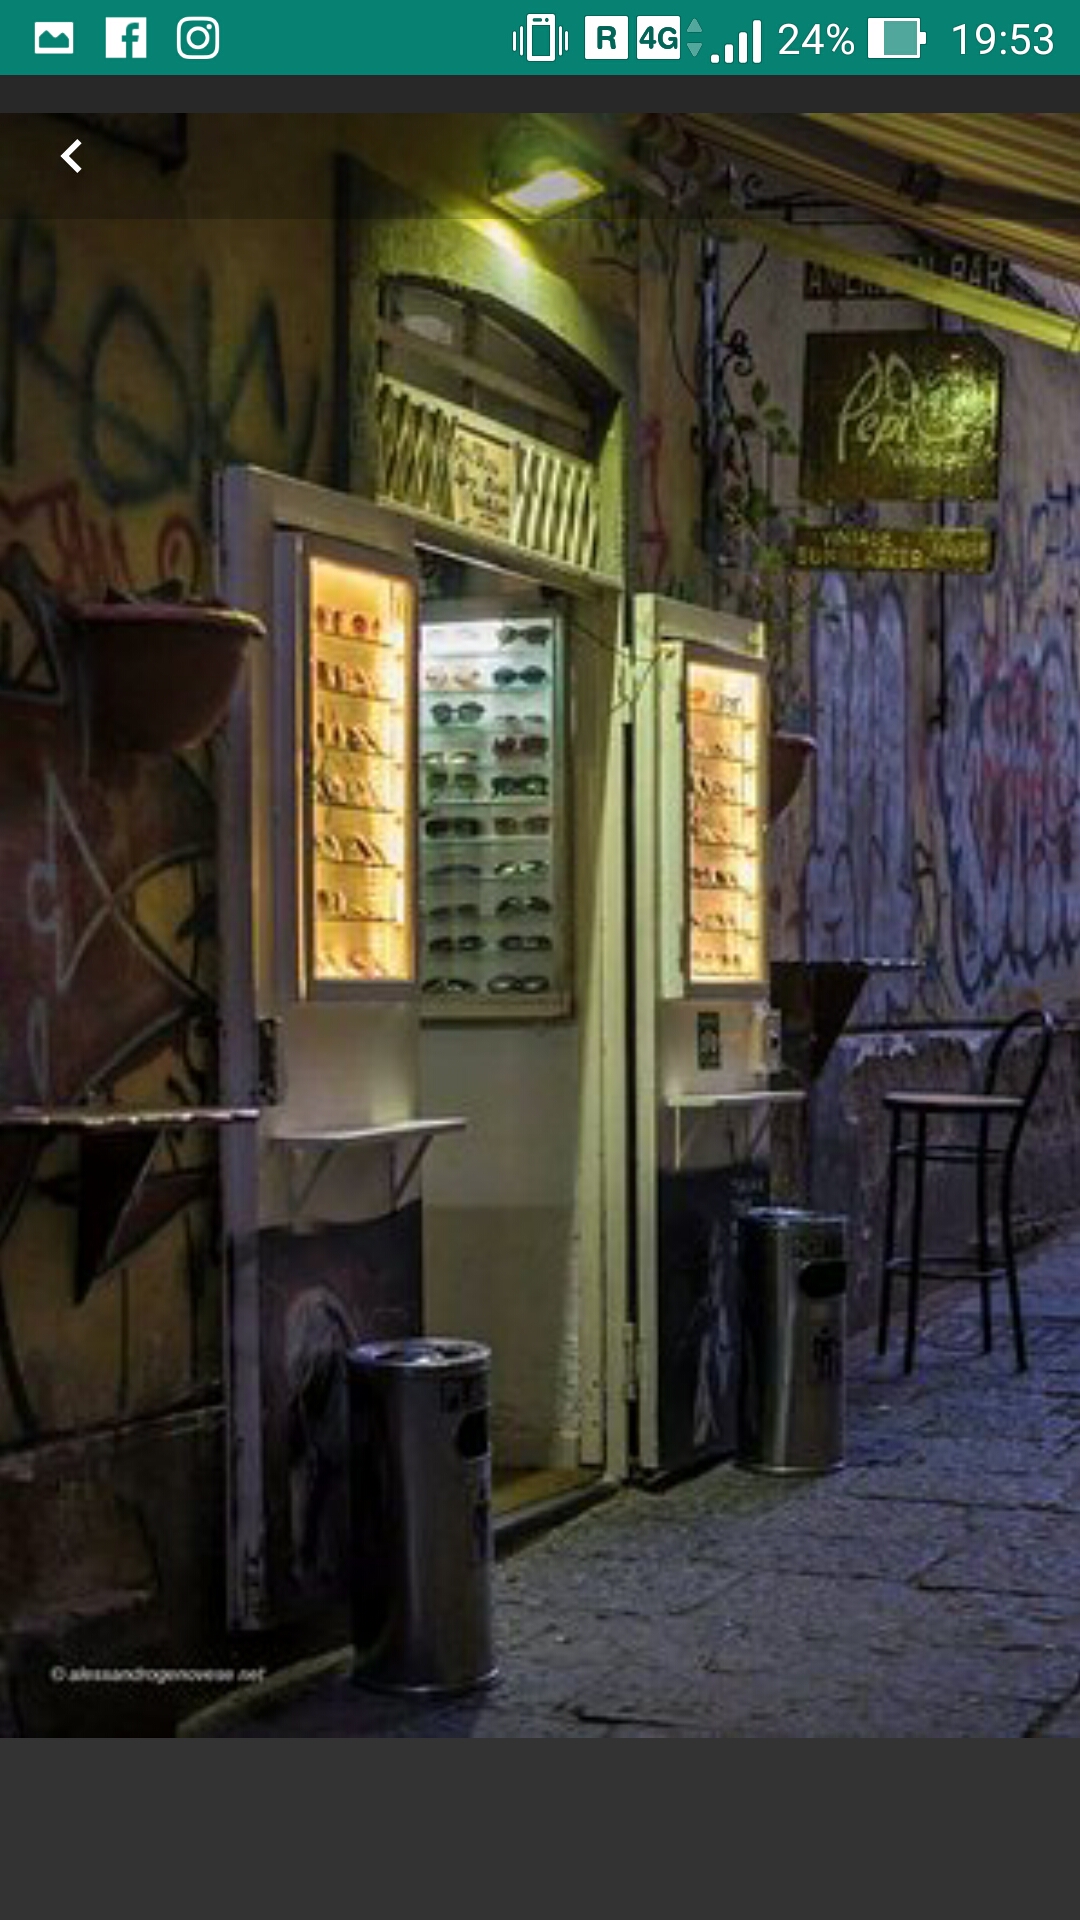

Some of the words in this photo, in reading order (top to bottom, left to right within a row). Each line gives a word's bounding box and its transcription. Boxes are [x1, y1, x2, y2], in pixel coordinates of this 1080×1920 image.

[638, 25, 679, 51] 4G
[778, 23, 855, 56] 24%
[952, 23, 1054, 56] 19:53
